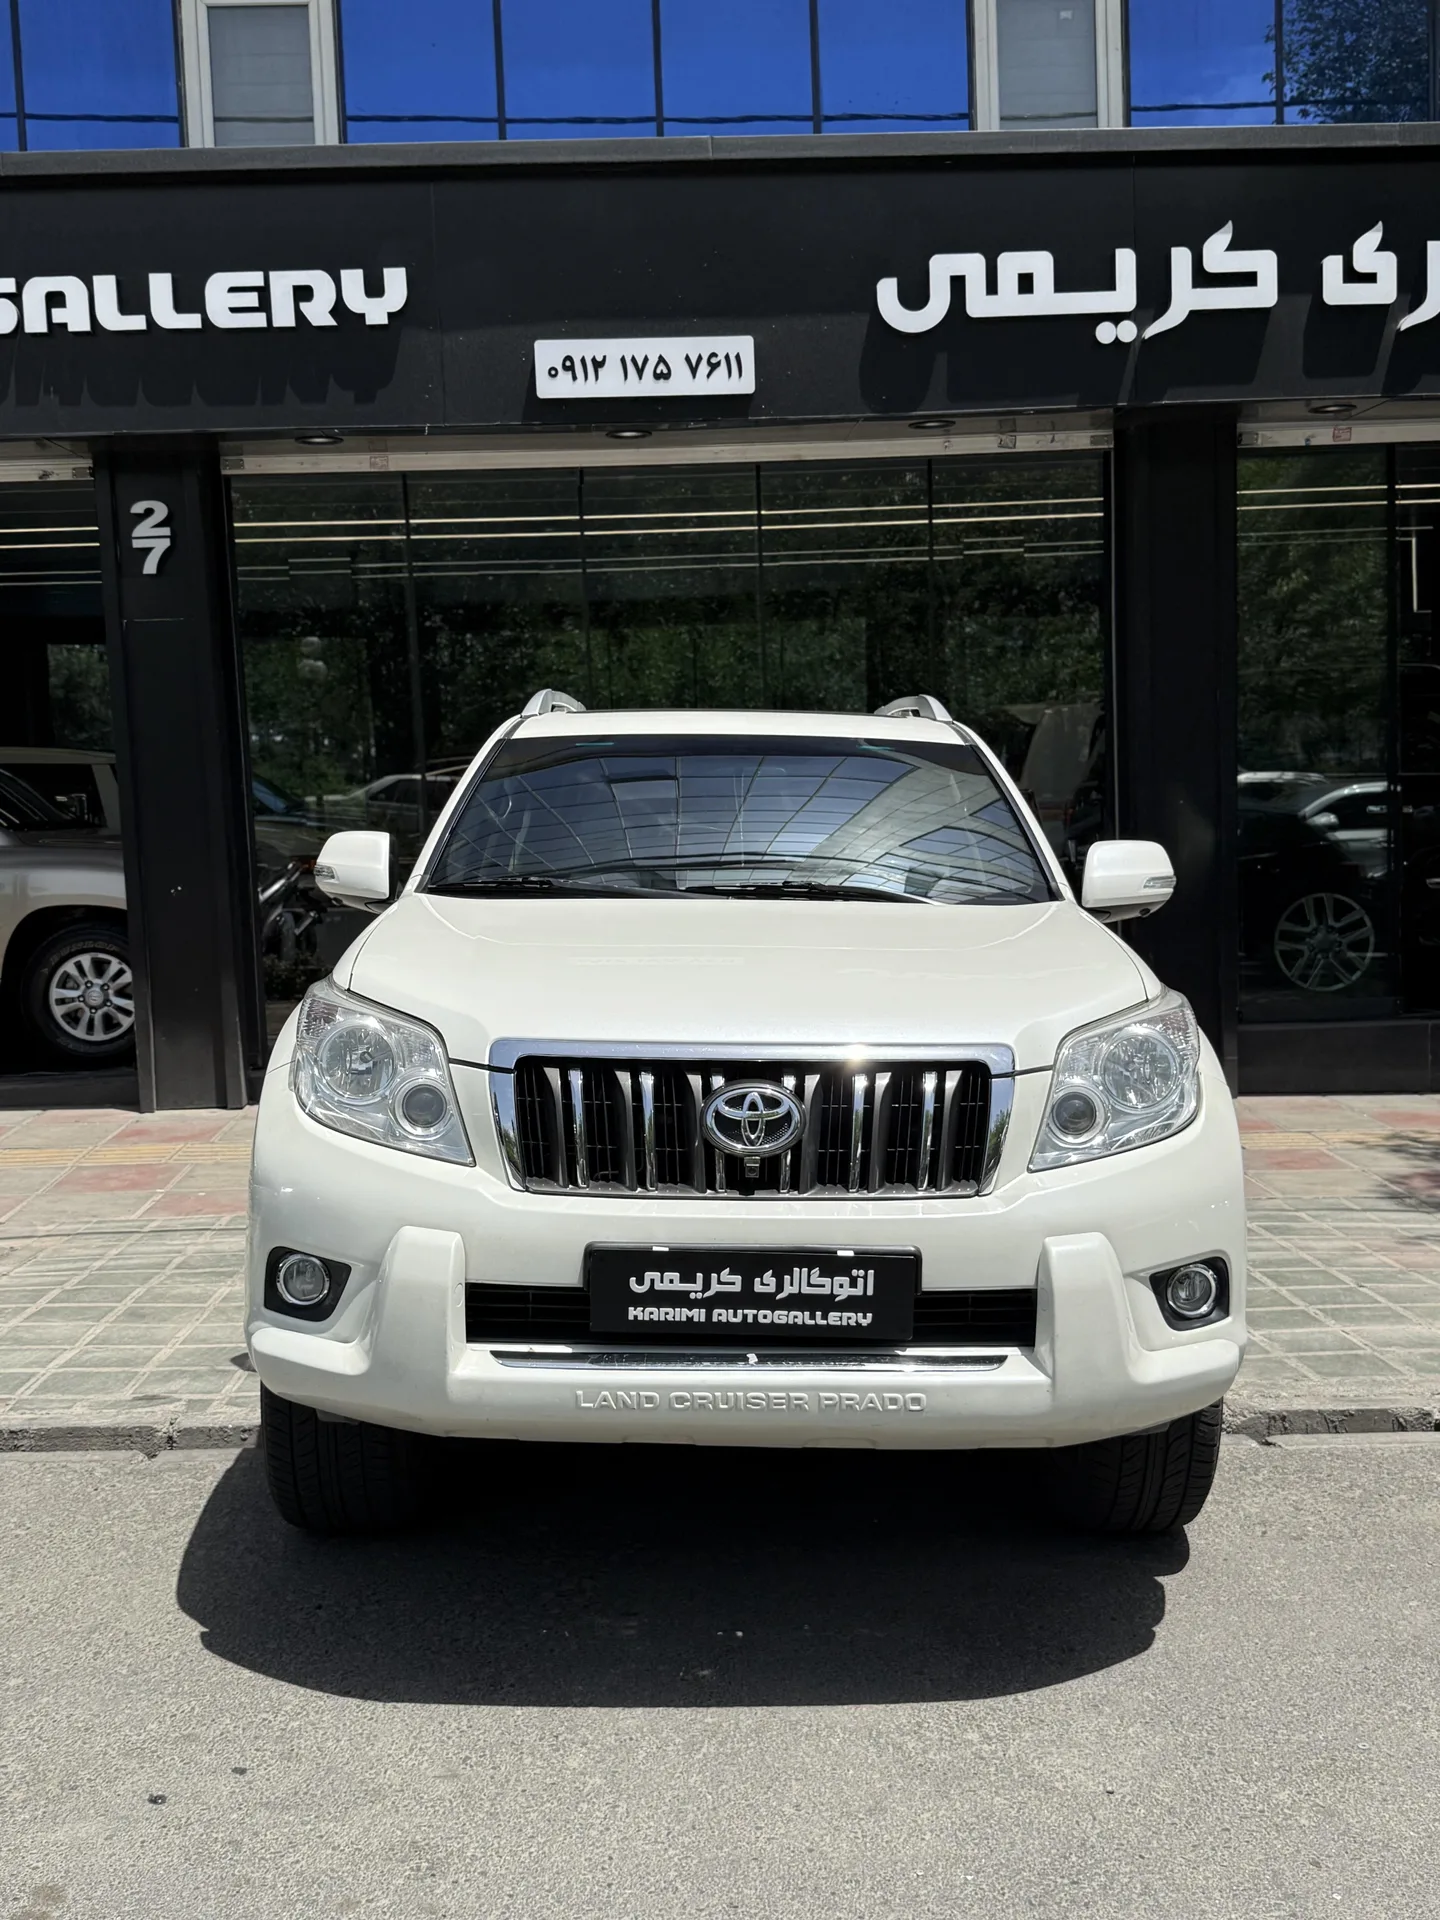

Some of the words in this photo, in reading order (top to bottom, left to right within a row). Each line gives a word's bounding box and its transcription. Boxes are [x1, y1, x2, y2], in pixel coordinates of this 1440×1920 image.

[876, 220, 1279, 345] کریمی
[547, 354, 607, 383] ۰۹۱۲
[619, 353, 673, 382] ۱۷۵
[684, 351, 743, 380] ۷۶۱۱
[629, 1267, 742, 1300] کریمی
[753, 1266, 875, 1302] اتوگالری
[627, 1306, 707, 1323] KARIMI
[711, 1308, 873, 1327] AUTOGALLERY
[575, 1389, 660, 1411] LAND
[668, 1390, 809, 1412] CRUISER
[817, 1391, 928, 1413] PRADO
